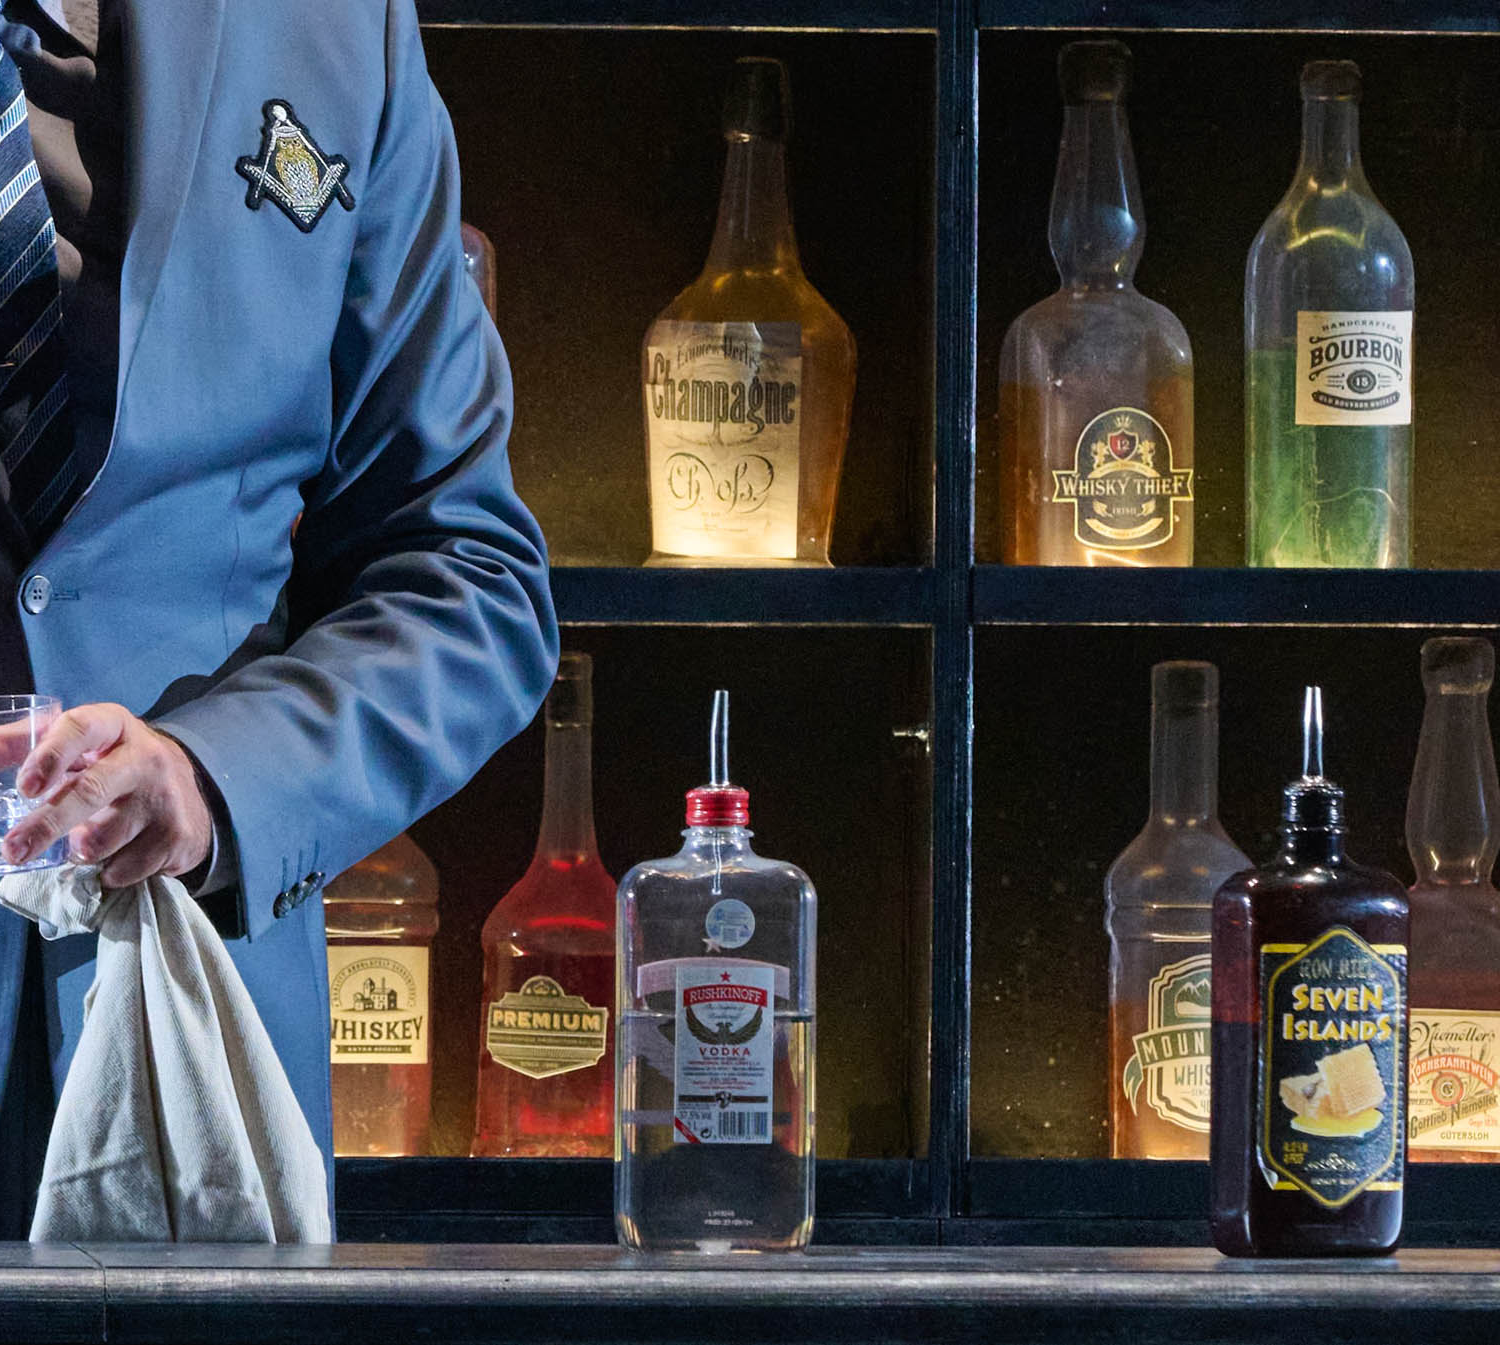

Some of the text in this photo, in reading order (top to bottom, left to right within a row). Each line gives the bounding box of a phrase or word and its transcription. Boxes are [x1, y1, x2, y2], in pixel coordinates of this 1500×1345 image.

[1310, 339, 1402, 370] BOURBON
[651, 352, 796, 437] Champagne
[1115, 439, 1130, 451] 12
[1060, 474, 1184, 496] WHISKY THIEF
[689, 986, 761, 1003] RUSHKINOFF
[1292, 983, 1383, 1012] SEVEN
[492, 1009, 600, 1031] PREMIUM
[1283, 1013, 1392, 1041] ISLANDS
[699, 1047, 750, 1057] VODKA
[1410, 1111, 1447, 1139] Gottlieb
[1441, 1130, 1489, 1140] GÜTERSLOH
